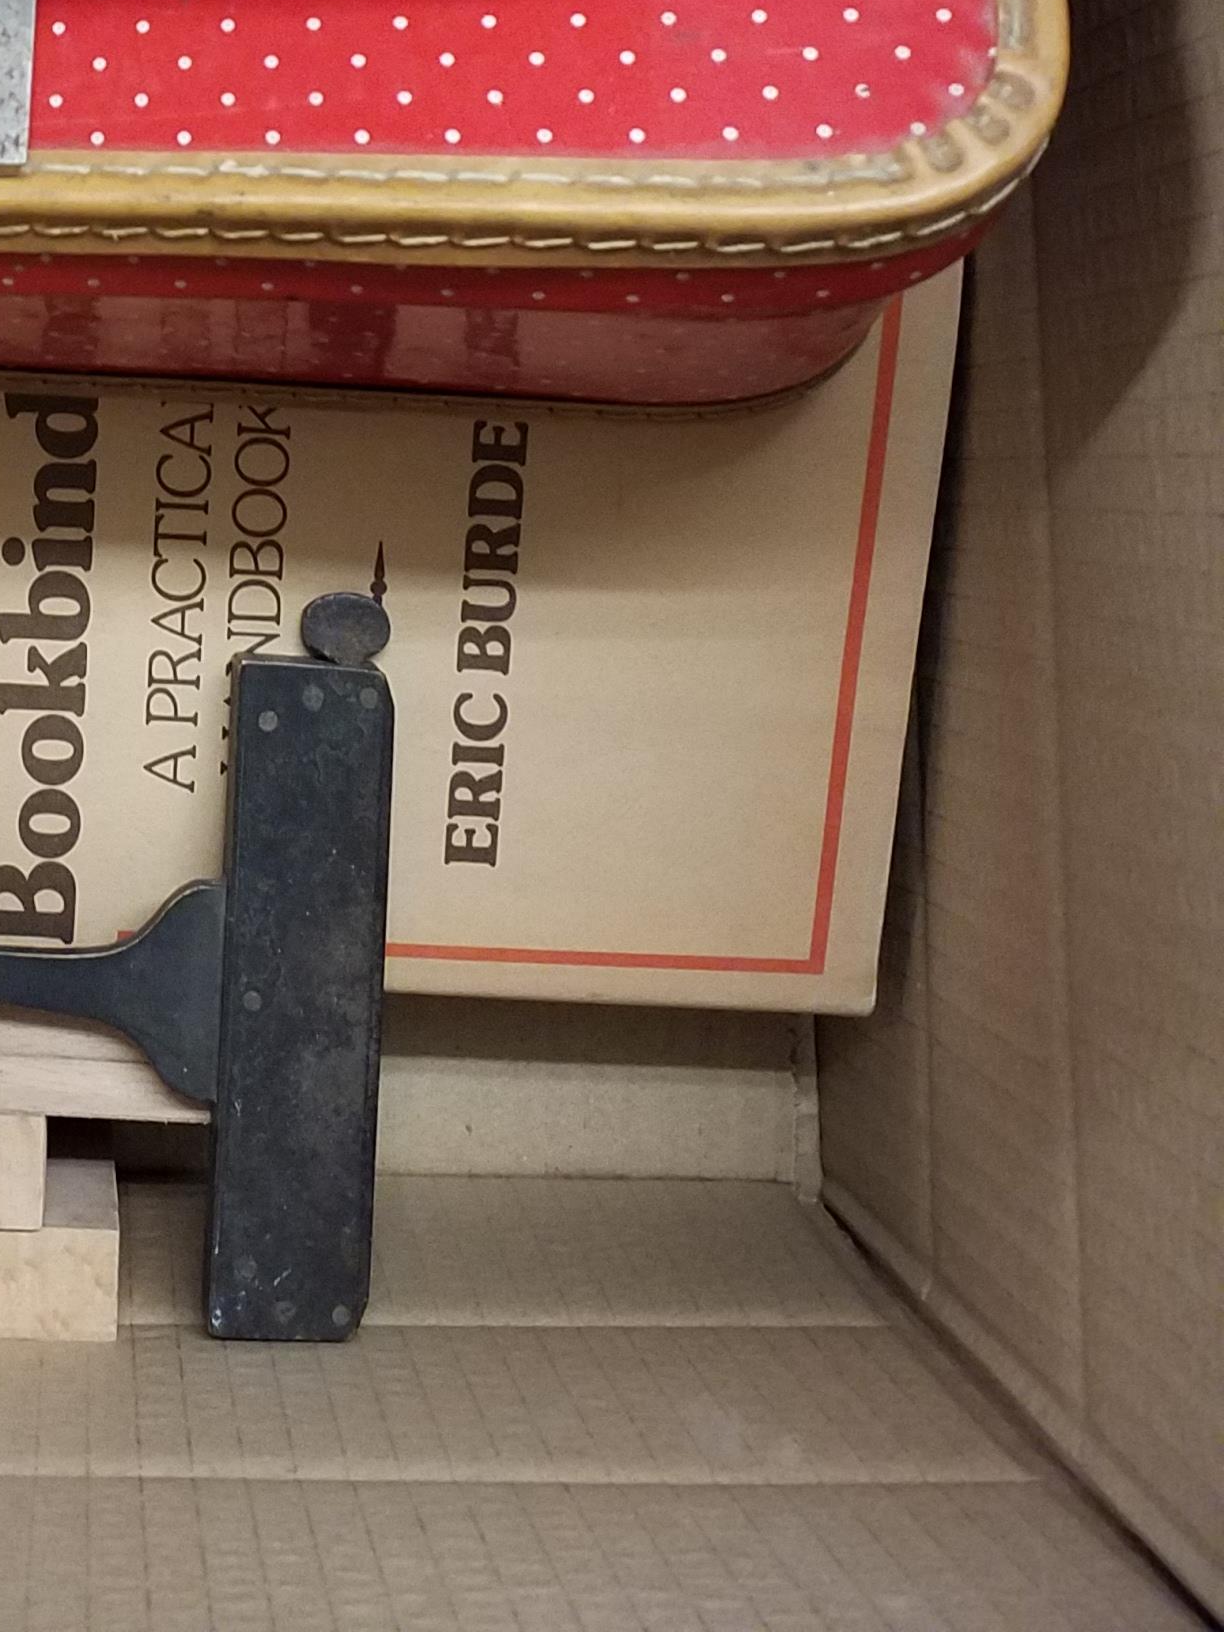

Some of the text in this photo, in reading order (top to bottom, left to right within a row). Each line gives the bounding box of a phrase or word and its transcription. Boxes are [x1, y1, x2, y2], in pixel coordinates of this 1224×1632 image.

[142, 399, 215, 793] A PRACTICA
[220, 403, 292, 778] NDBOOK
[443, 419, 530, 869] ERIC BURDE
